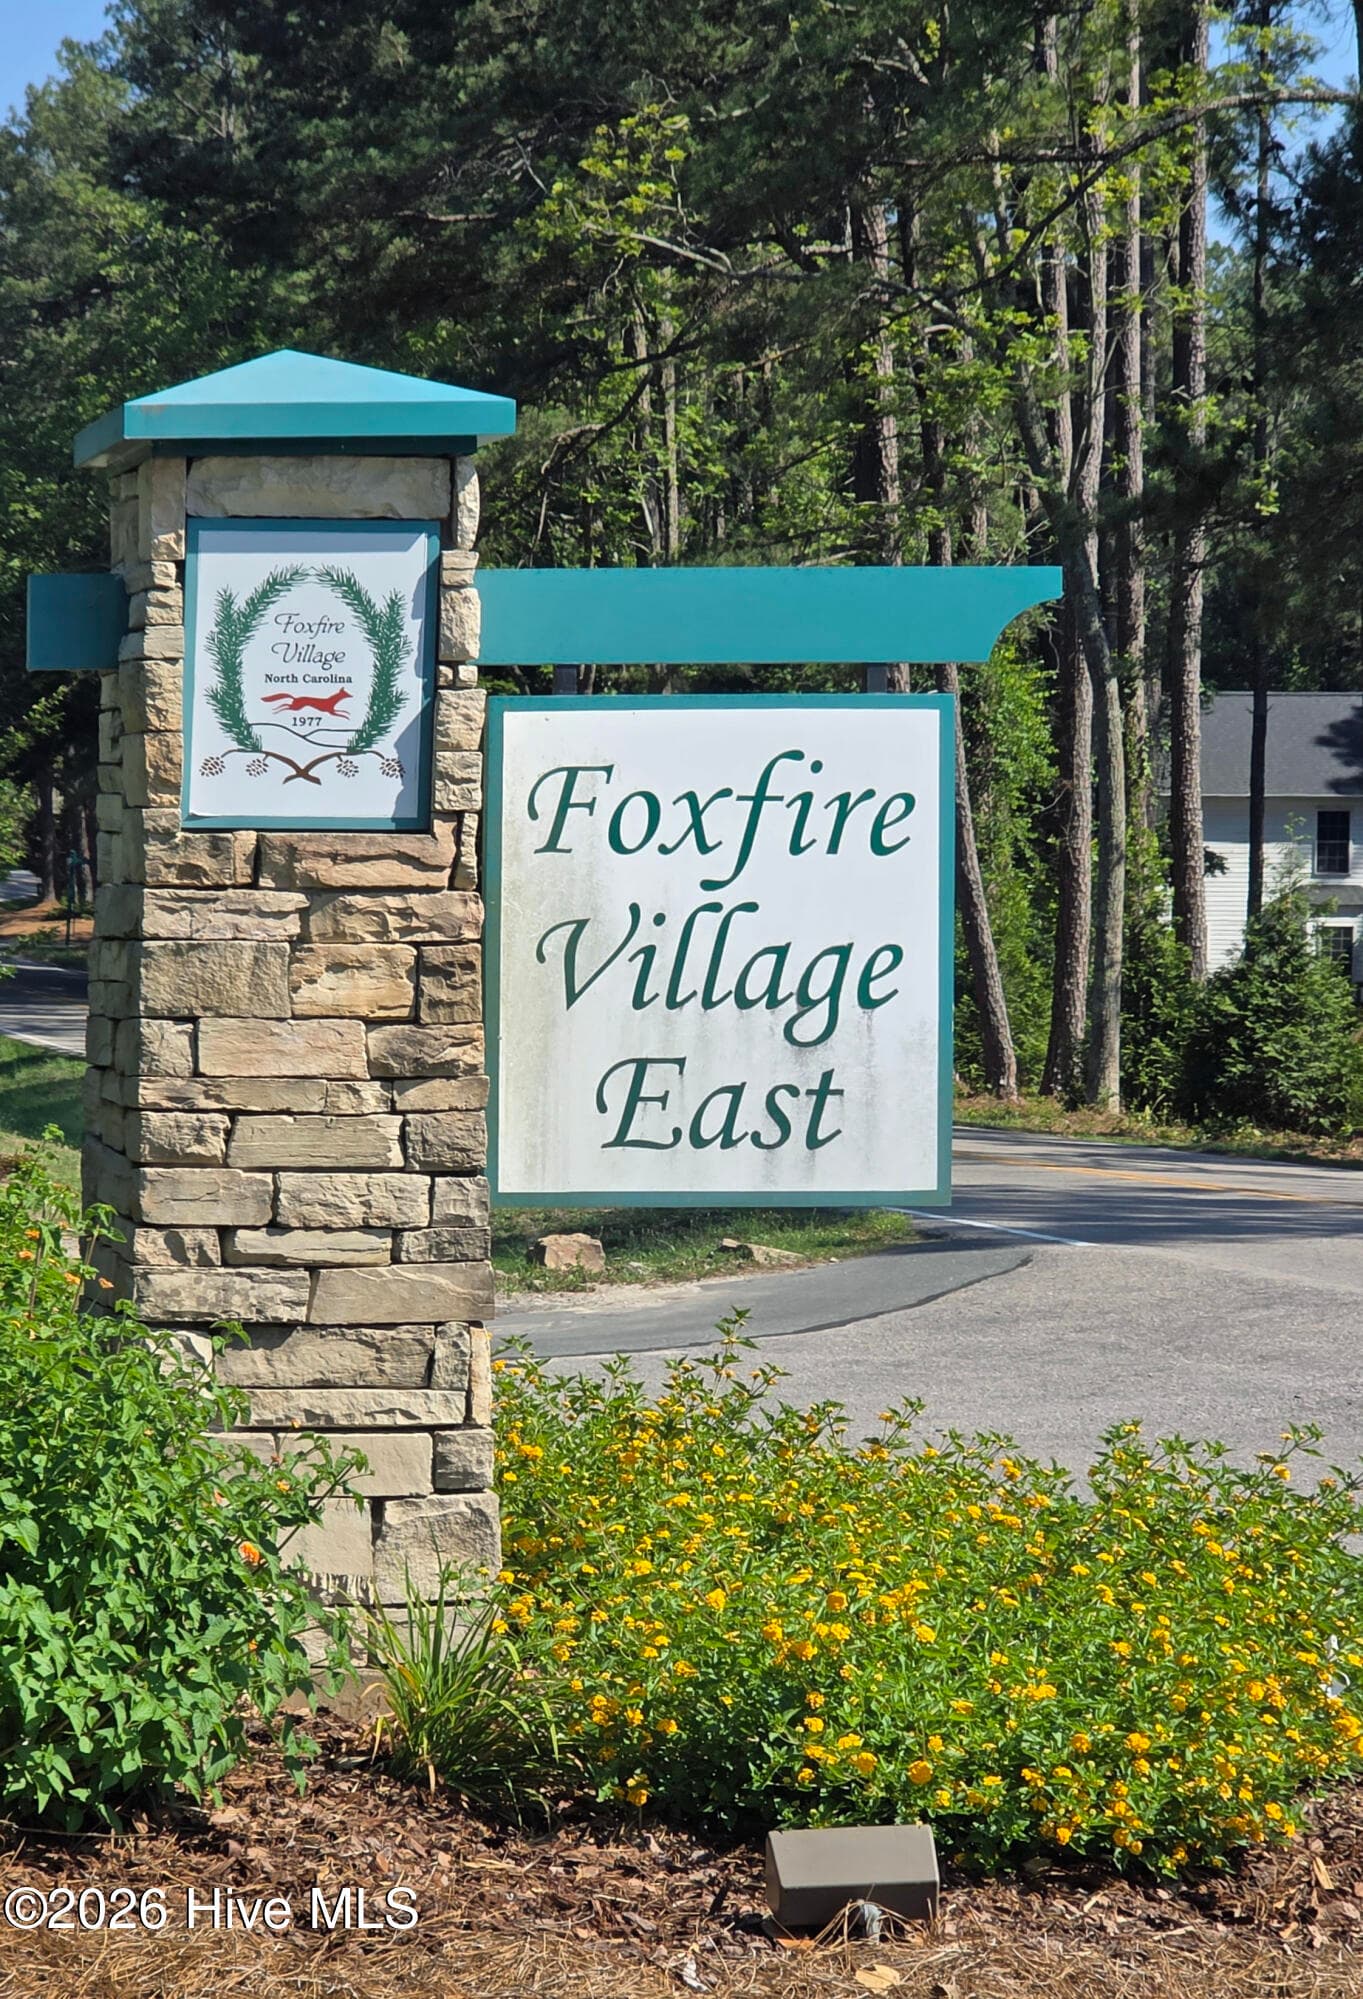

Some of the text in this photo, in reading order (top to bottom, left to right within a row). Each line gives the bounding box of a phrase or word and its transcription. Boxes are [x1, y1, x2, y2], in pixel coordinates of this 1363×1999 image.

[274, 612, 345, 639] Foxfire
[271, 642, 346, 671] Village
[264, 673, 353, 684] North Carolina
[292, 716, 323, 727] 1977
[527, 749, 917, 892] Foxfire
[535, 901, 904, 1049] Village
[595, 1056, 845, 1151] East
